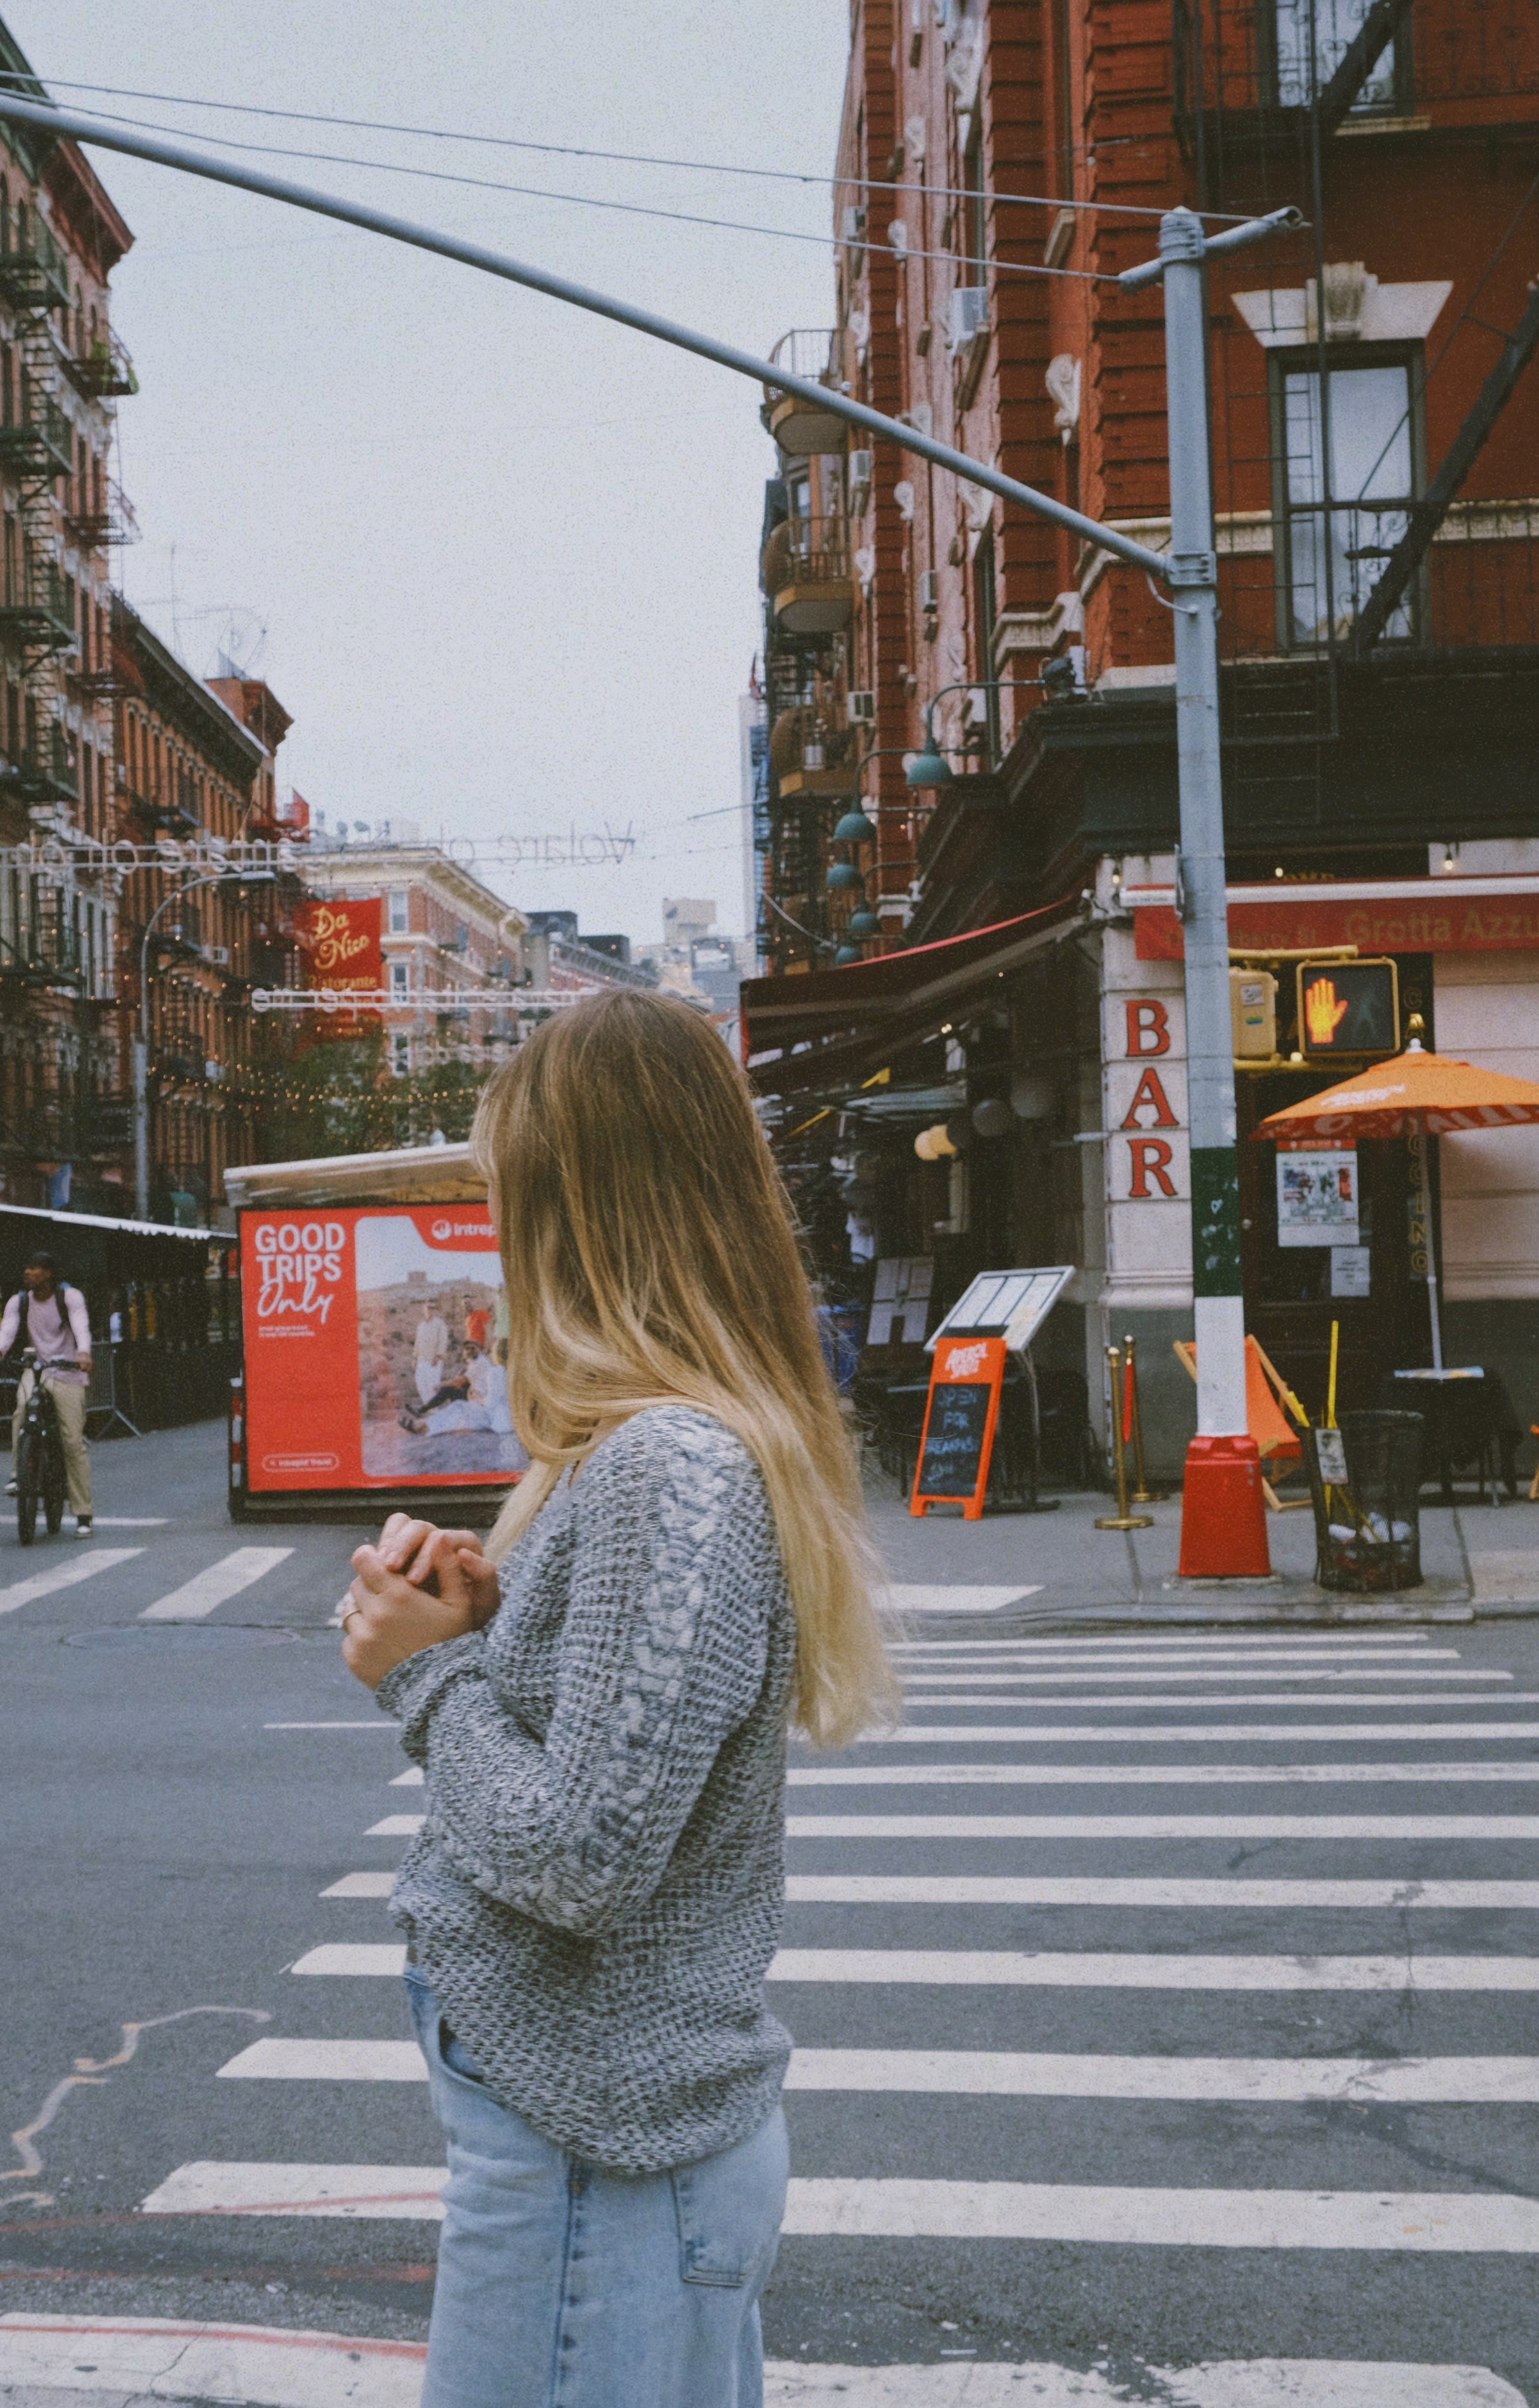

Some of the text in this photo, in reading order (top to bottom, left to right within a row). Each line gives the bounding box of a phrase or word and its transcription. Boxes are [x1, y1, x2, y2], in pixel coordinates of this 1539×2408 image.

[311, 907, 349, 940] Da
[1346, 909, 1450, 944] Grotta
[315, 930, 370, 969] Nico
[1121, 999, 1179, 1197] BAR
[255, 1223, 346, 1253] GOOD
[454, 1223, 497, 1238] Intrep
[255, 1253, 342, 1282] TRIPS
[258, 1275, 334, 1324] Only
